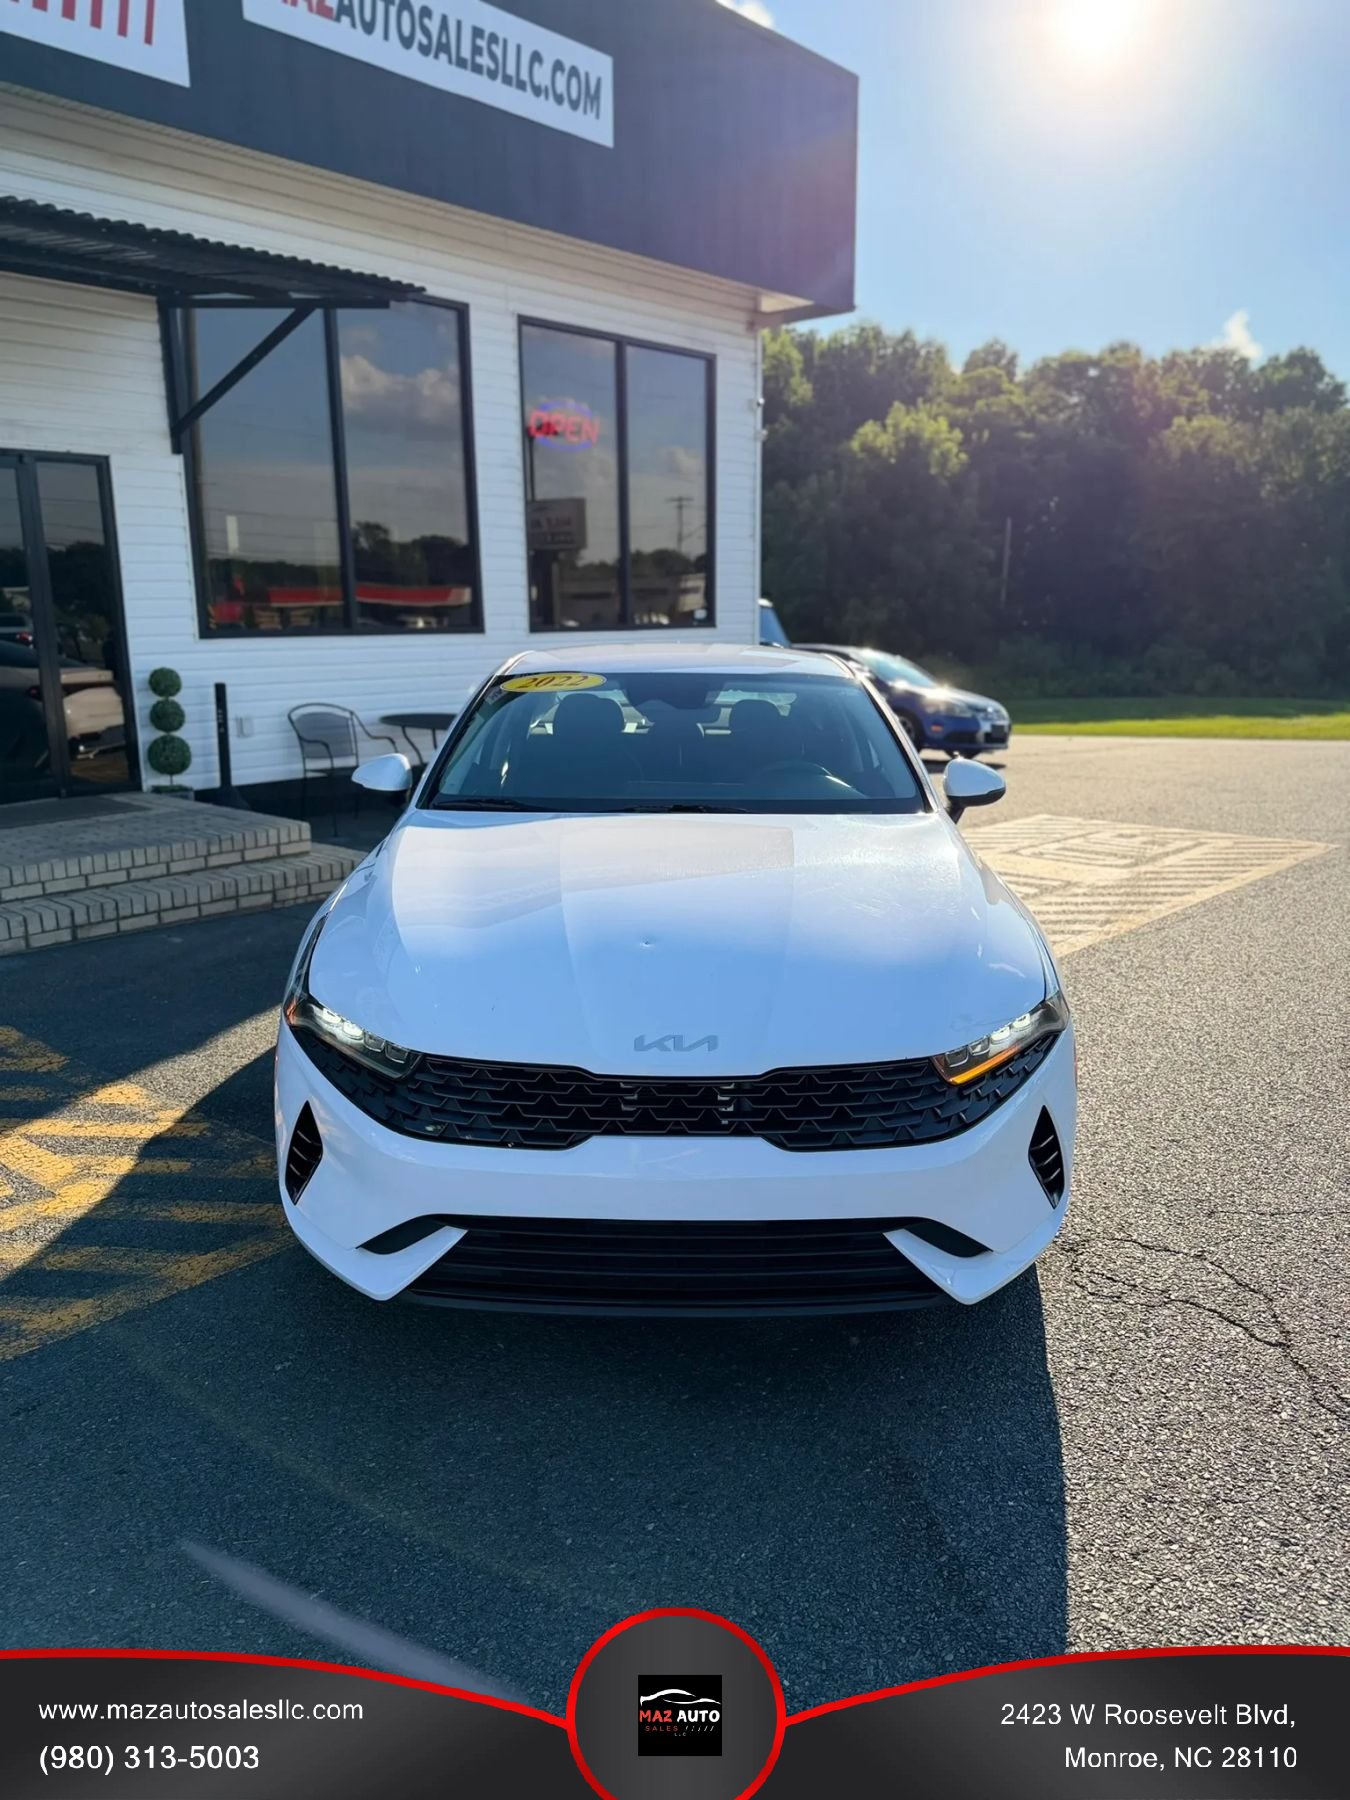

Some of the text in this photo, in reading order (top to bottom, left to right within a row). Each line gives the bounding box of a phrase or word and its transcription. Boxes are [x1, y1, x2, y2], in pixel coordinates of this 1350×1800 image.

[281, 0, 602, 120] AUTOSALESLLC.COM
[528, 409, 600, 447] OPEN
[517, 675, 589, 689] 2022
